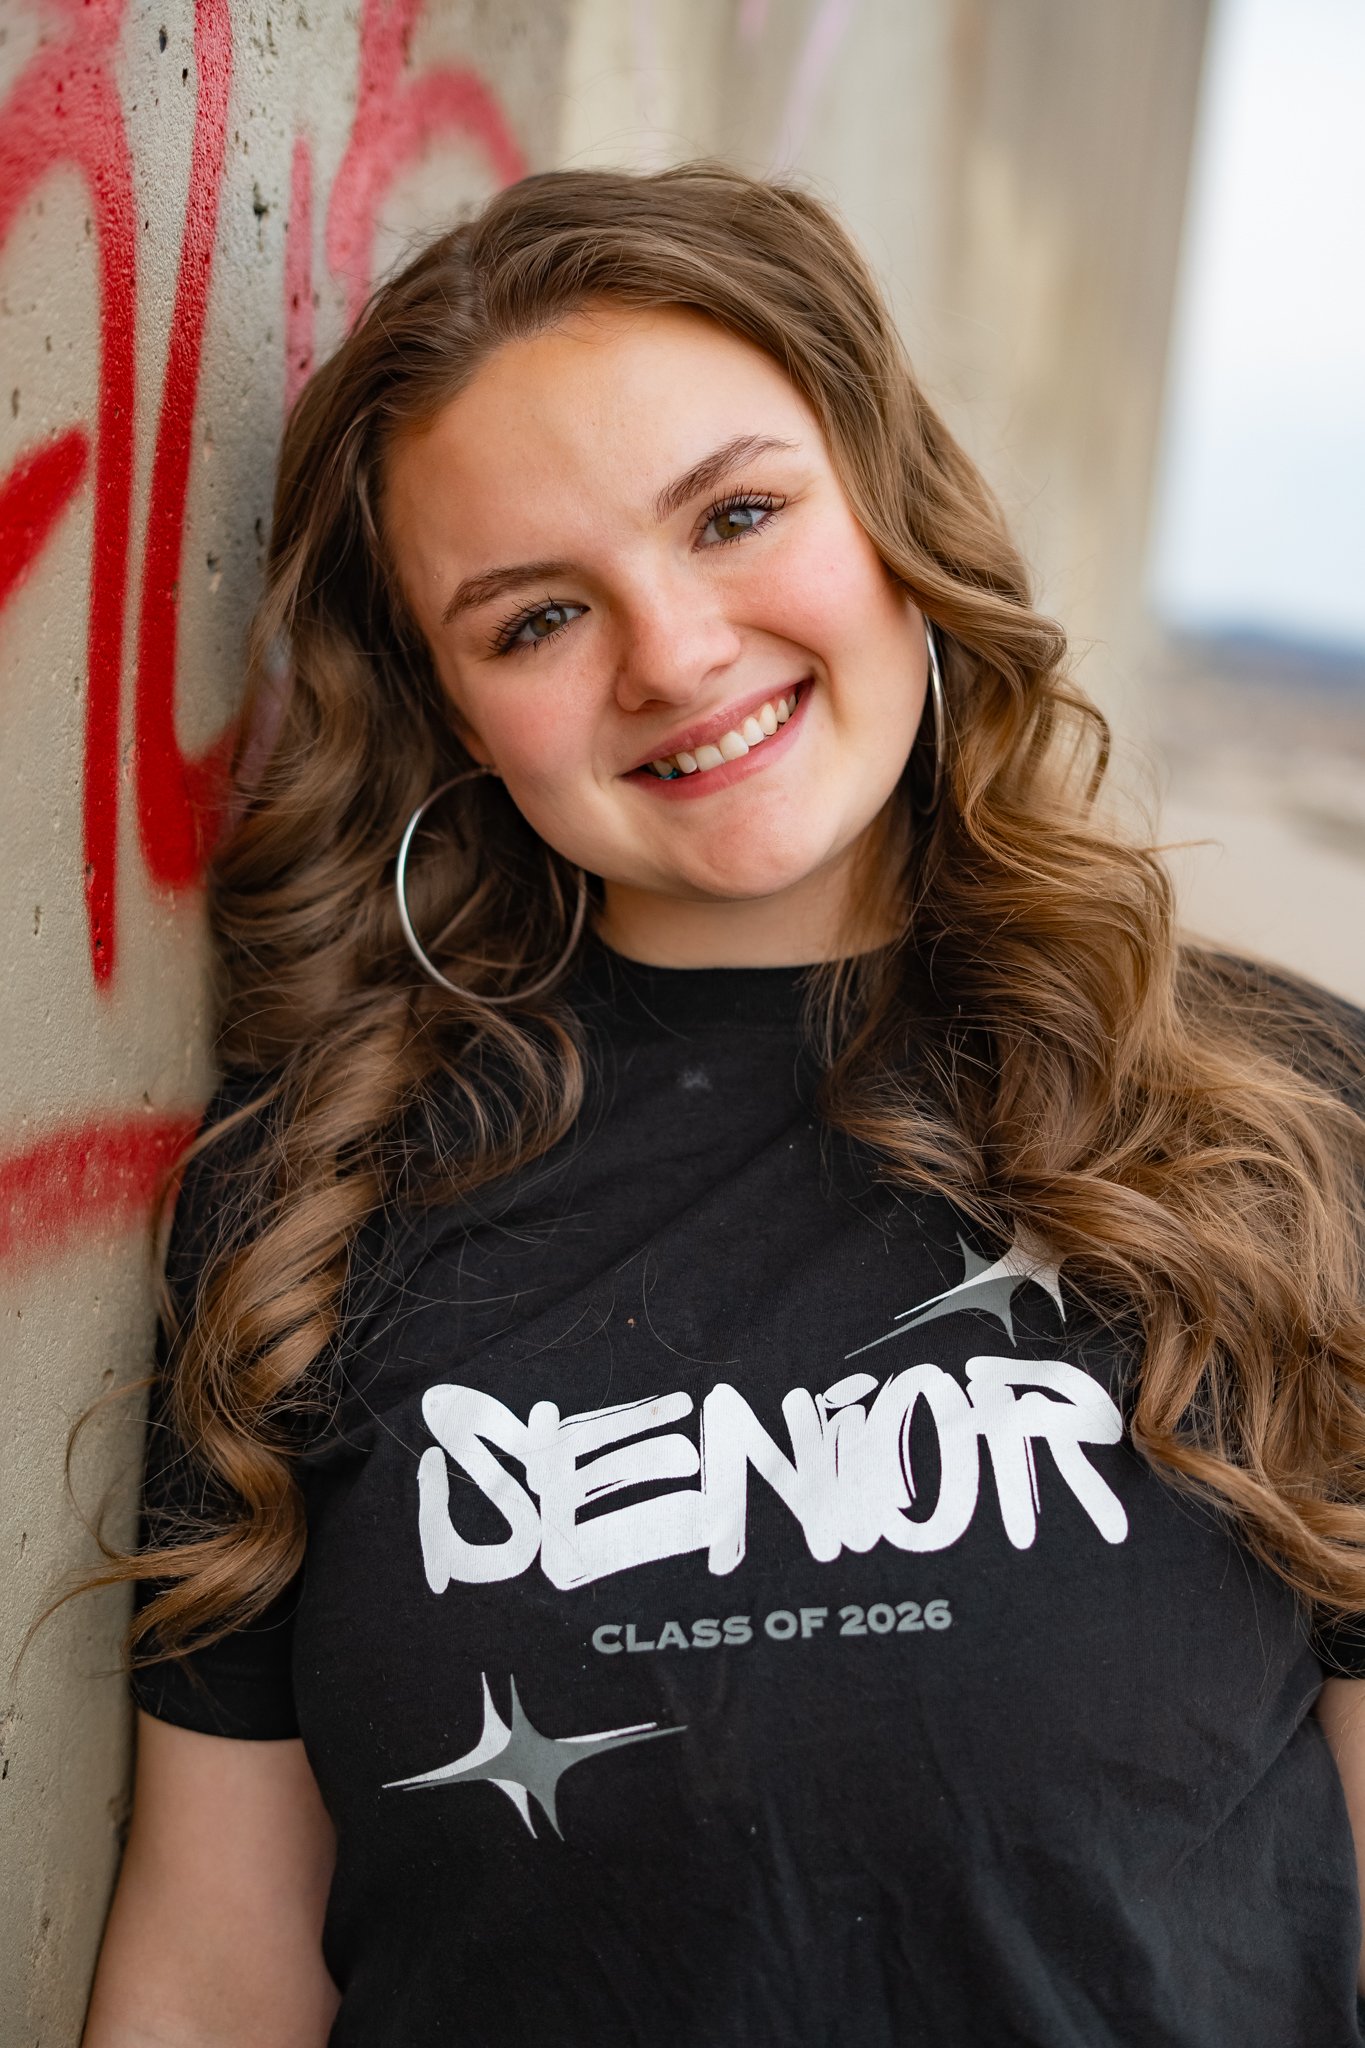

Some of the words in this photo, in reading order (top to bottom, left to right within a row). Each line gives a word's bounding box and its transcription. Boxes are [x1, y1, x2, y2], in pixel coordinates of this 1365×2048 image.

[592, 1616, 752, 1655] CLASS
[765, 1607, 828, 1641] OF
[839, 1600, 952, 1635] 2026
